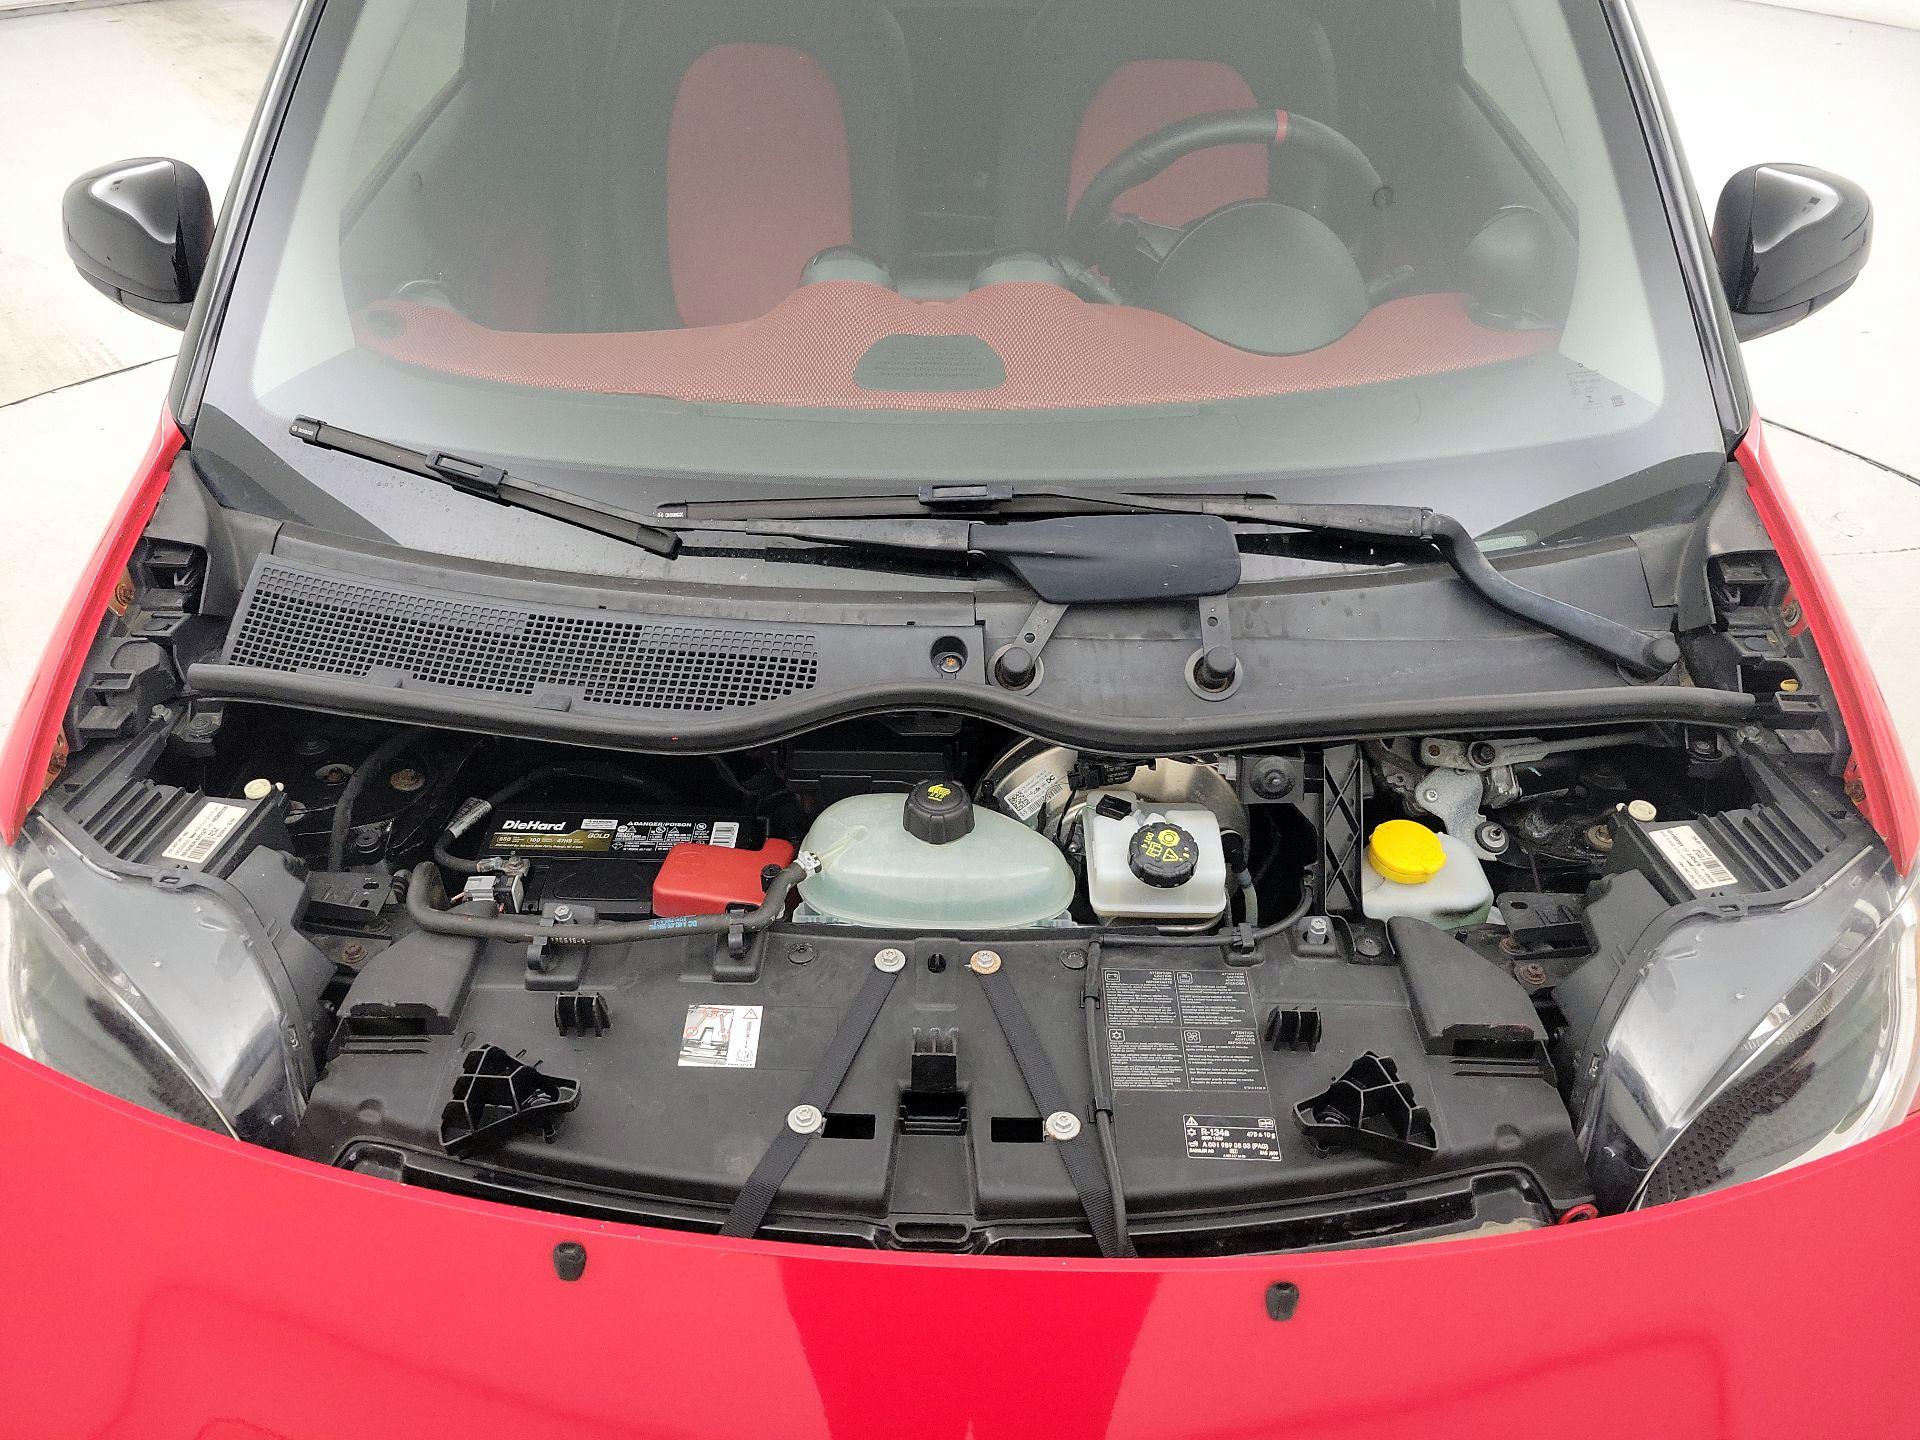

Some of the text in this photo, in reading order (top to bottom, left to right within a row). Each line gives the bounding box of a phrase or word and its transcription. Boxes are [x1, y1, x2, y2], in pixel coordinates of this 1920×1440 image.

[502, 820, 566, 831] DieHard
[1200, 1128, 1230, 1137] R-134a
[1252, 1143, 1269, 1151] (PAG)
